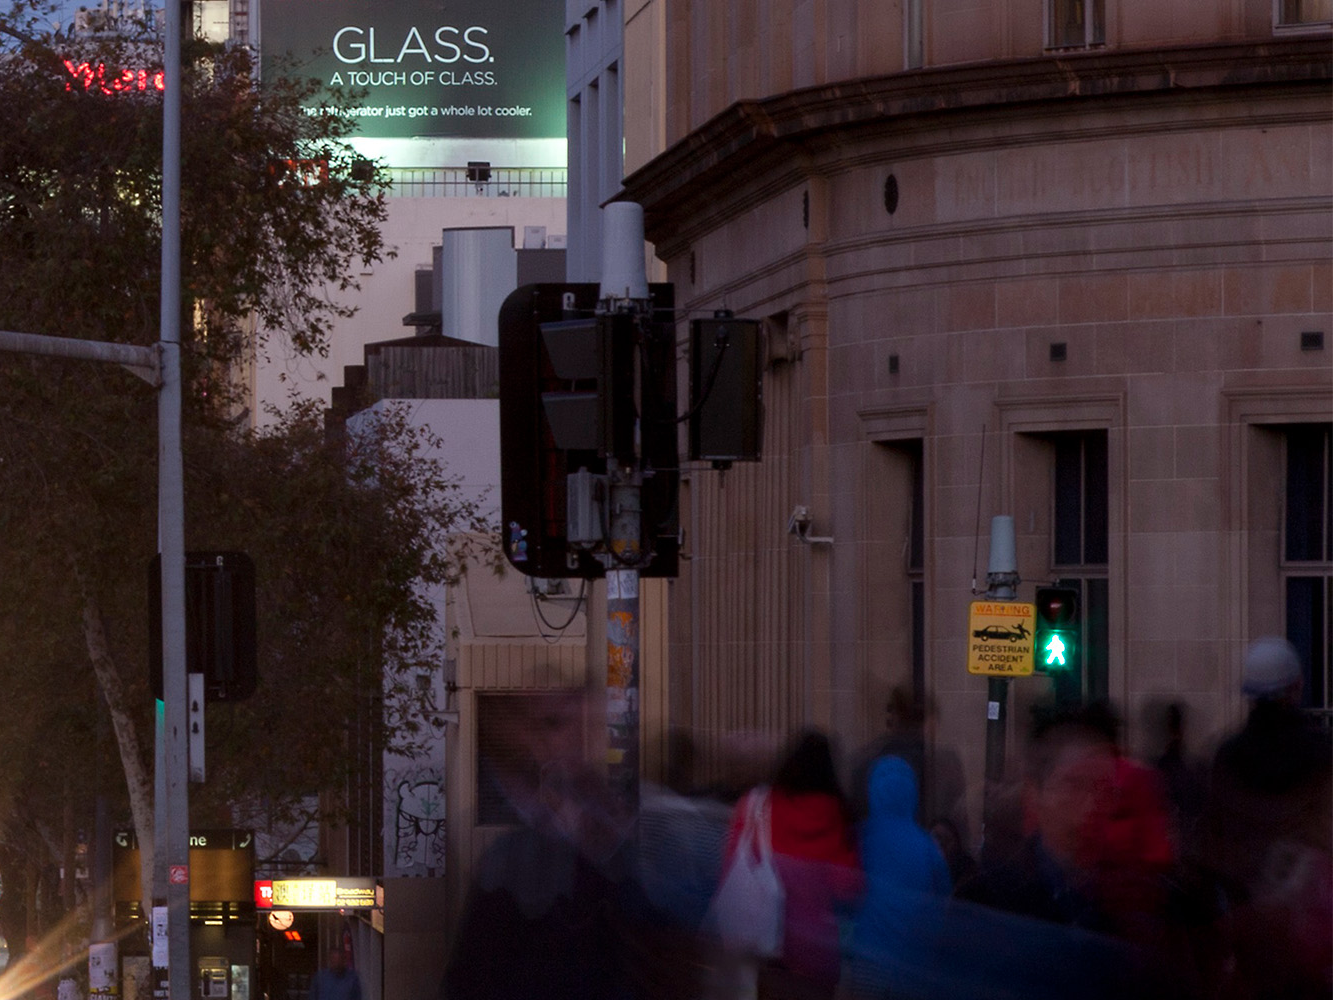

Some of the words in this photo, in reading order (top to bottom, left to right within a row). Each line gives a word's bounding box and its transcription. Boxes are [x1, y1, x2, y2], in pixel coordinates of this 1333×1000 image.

[333, 26, 494, 64] GLASS.
[330, 72, 343, 86] A
[347, 72, 406, 86] TOUCH
[410, 72, 435, 86] OF
[439, 72, 498, 86] CLASS.
[385, 105, 406, 117] just
[408, 106, 428, 117] got
[430, 107, 438, 116] a
[441, 105, 475, 116] whole
[477, 105, 492, 116] lot
[495, 105, 532, 116] cooler.
[975, 604, 1030, 615] WARNING
[973, 644, 1030, 653] PEDESTRIAN
[978, 654, 1024, 662] ACCIDENT
[988, 663, 1013, 671] AREA
